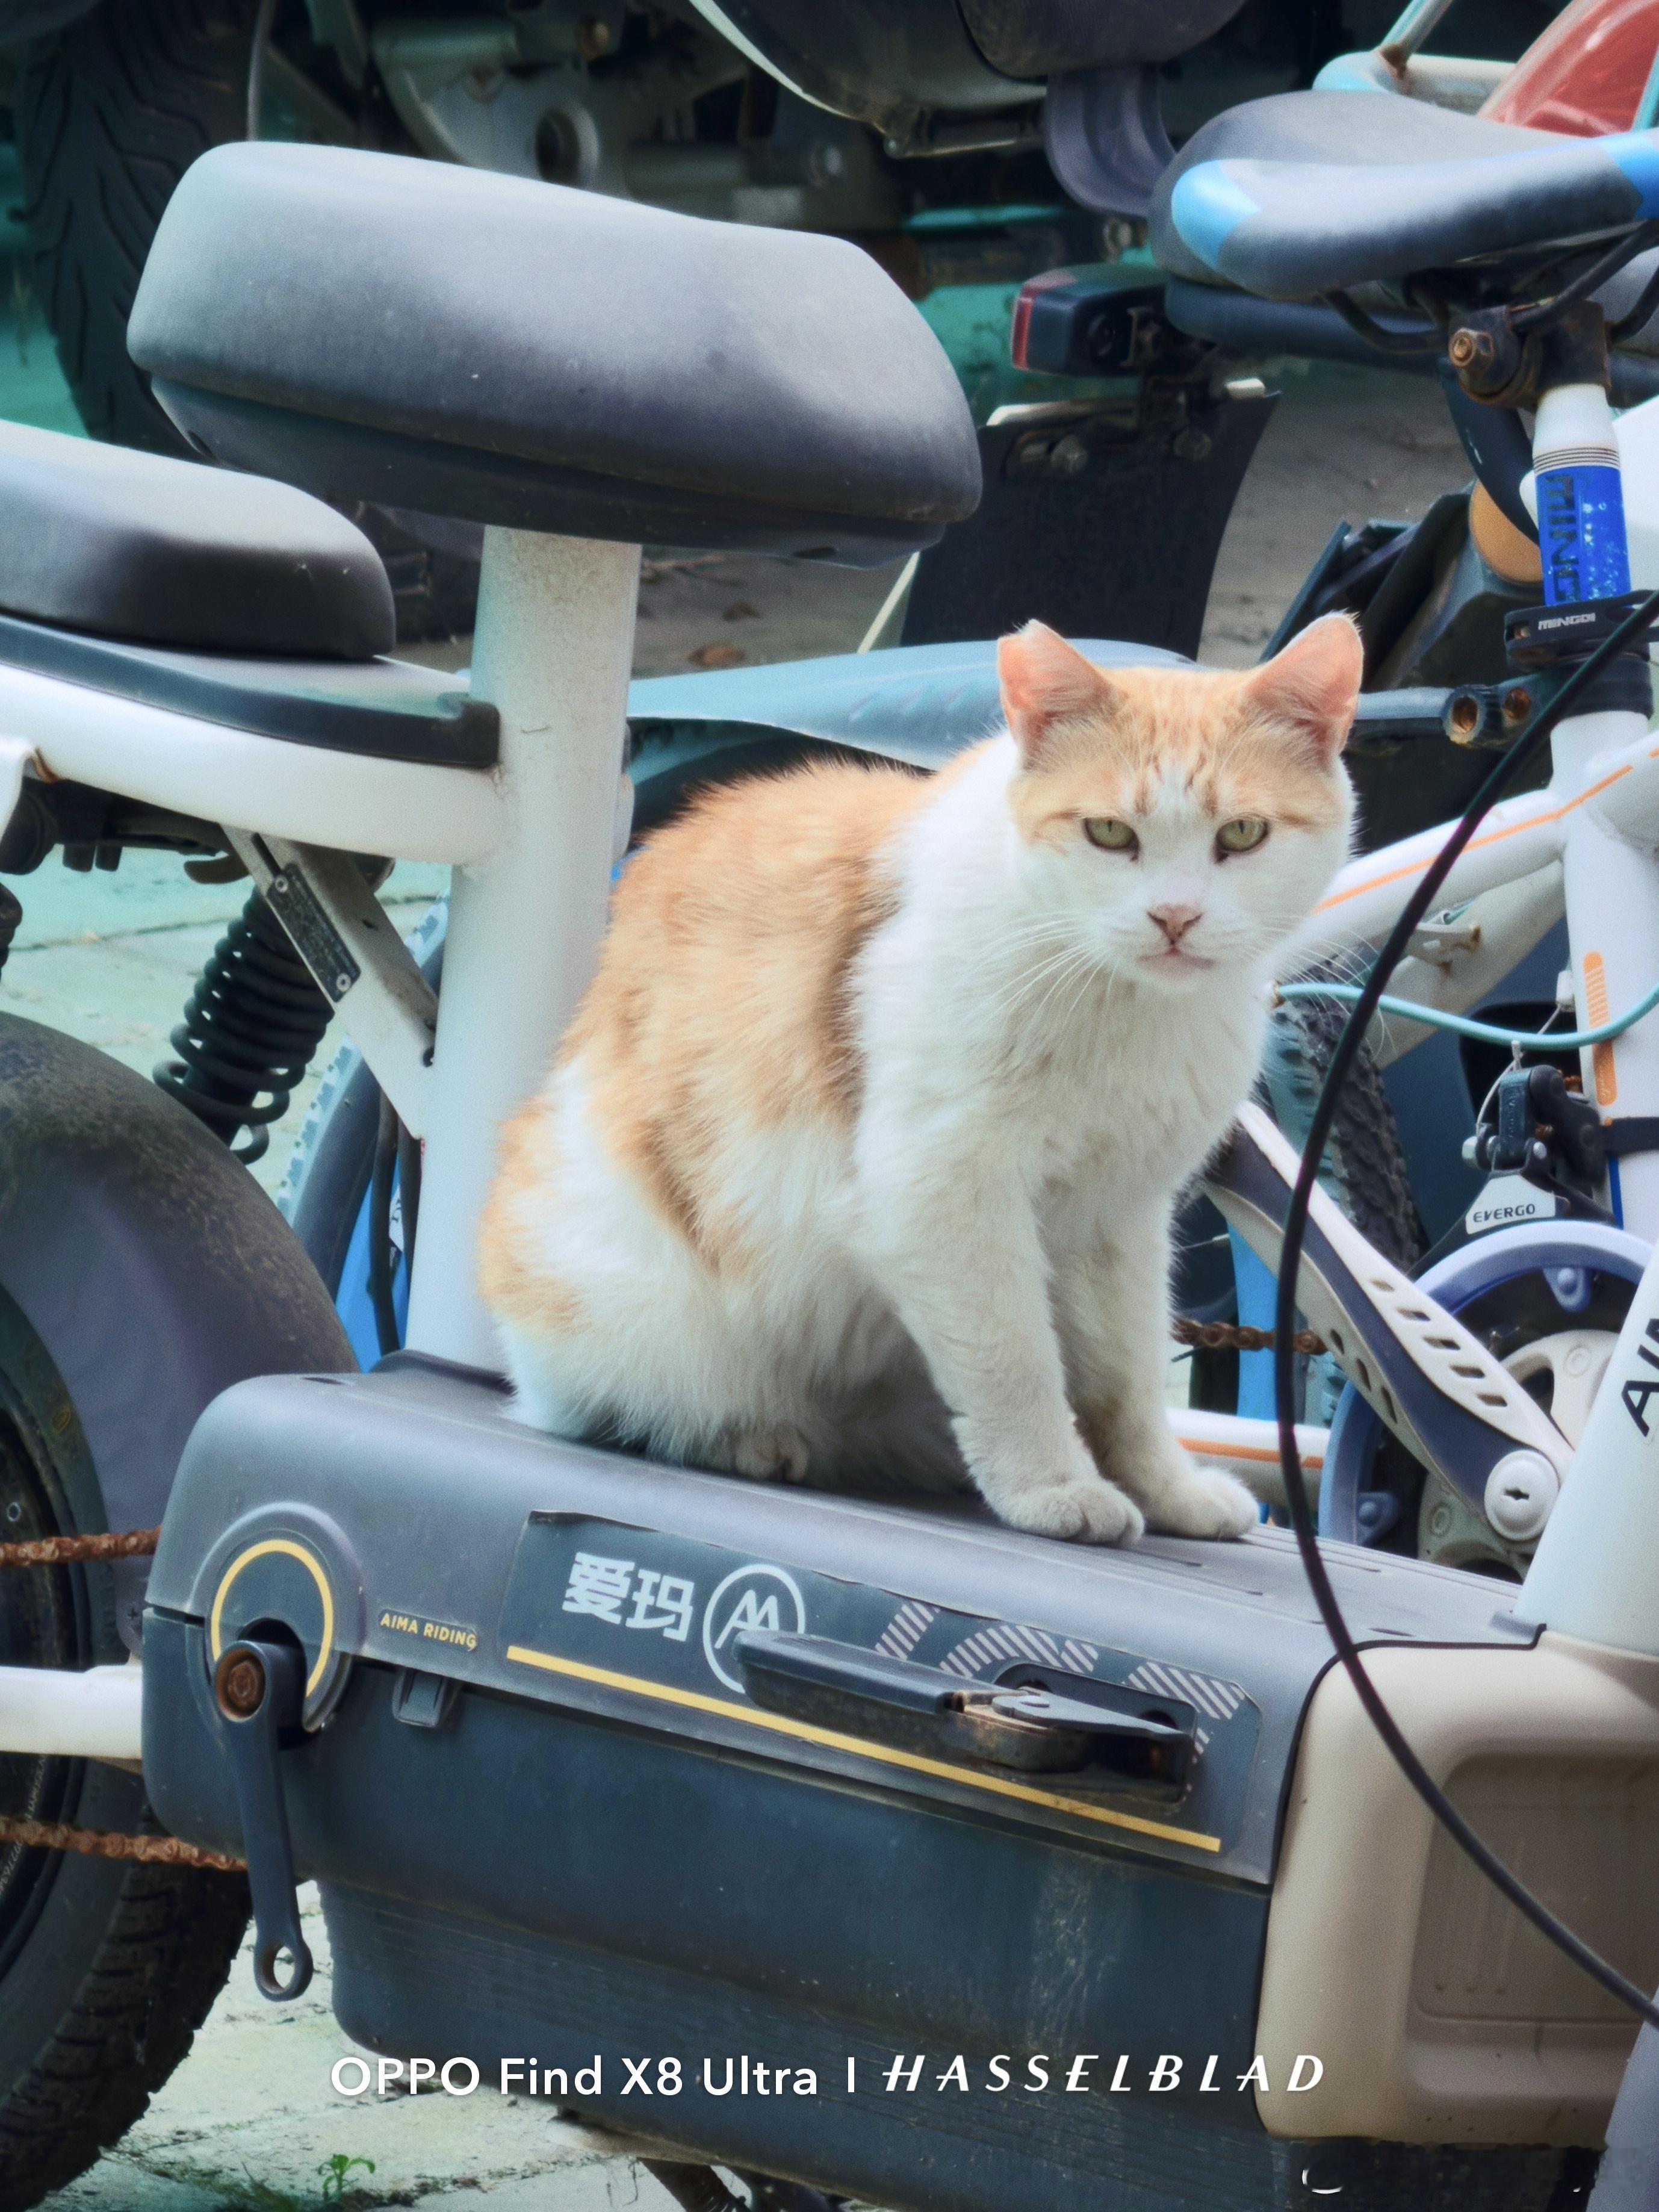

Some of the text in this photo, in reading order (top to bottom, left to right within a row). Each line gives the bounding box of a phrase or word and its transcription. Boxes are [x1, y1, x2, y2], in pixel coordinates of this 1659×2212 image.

[1473, 1204, 1535, 1223] EVERGO
[562, 1552, 695, 1642] 爱玛
[380, 1613, 477, 1650] AIMA RIDING
